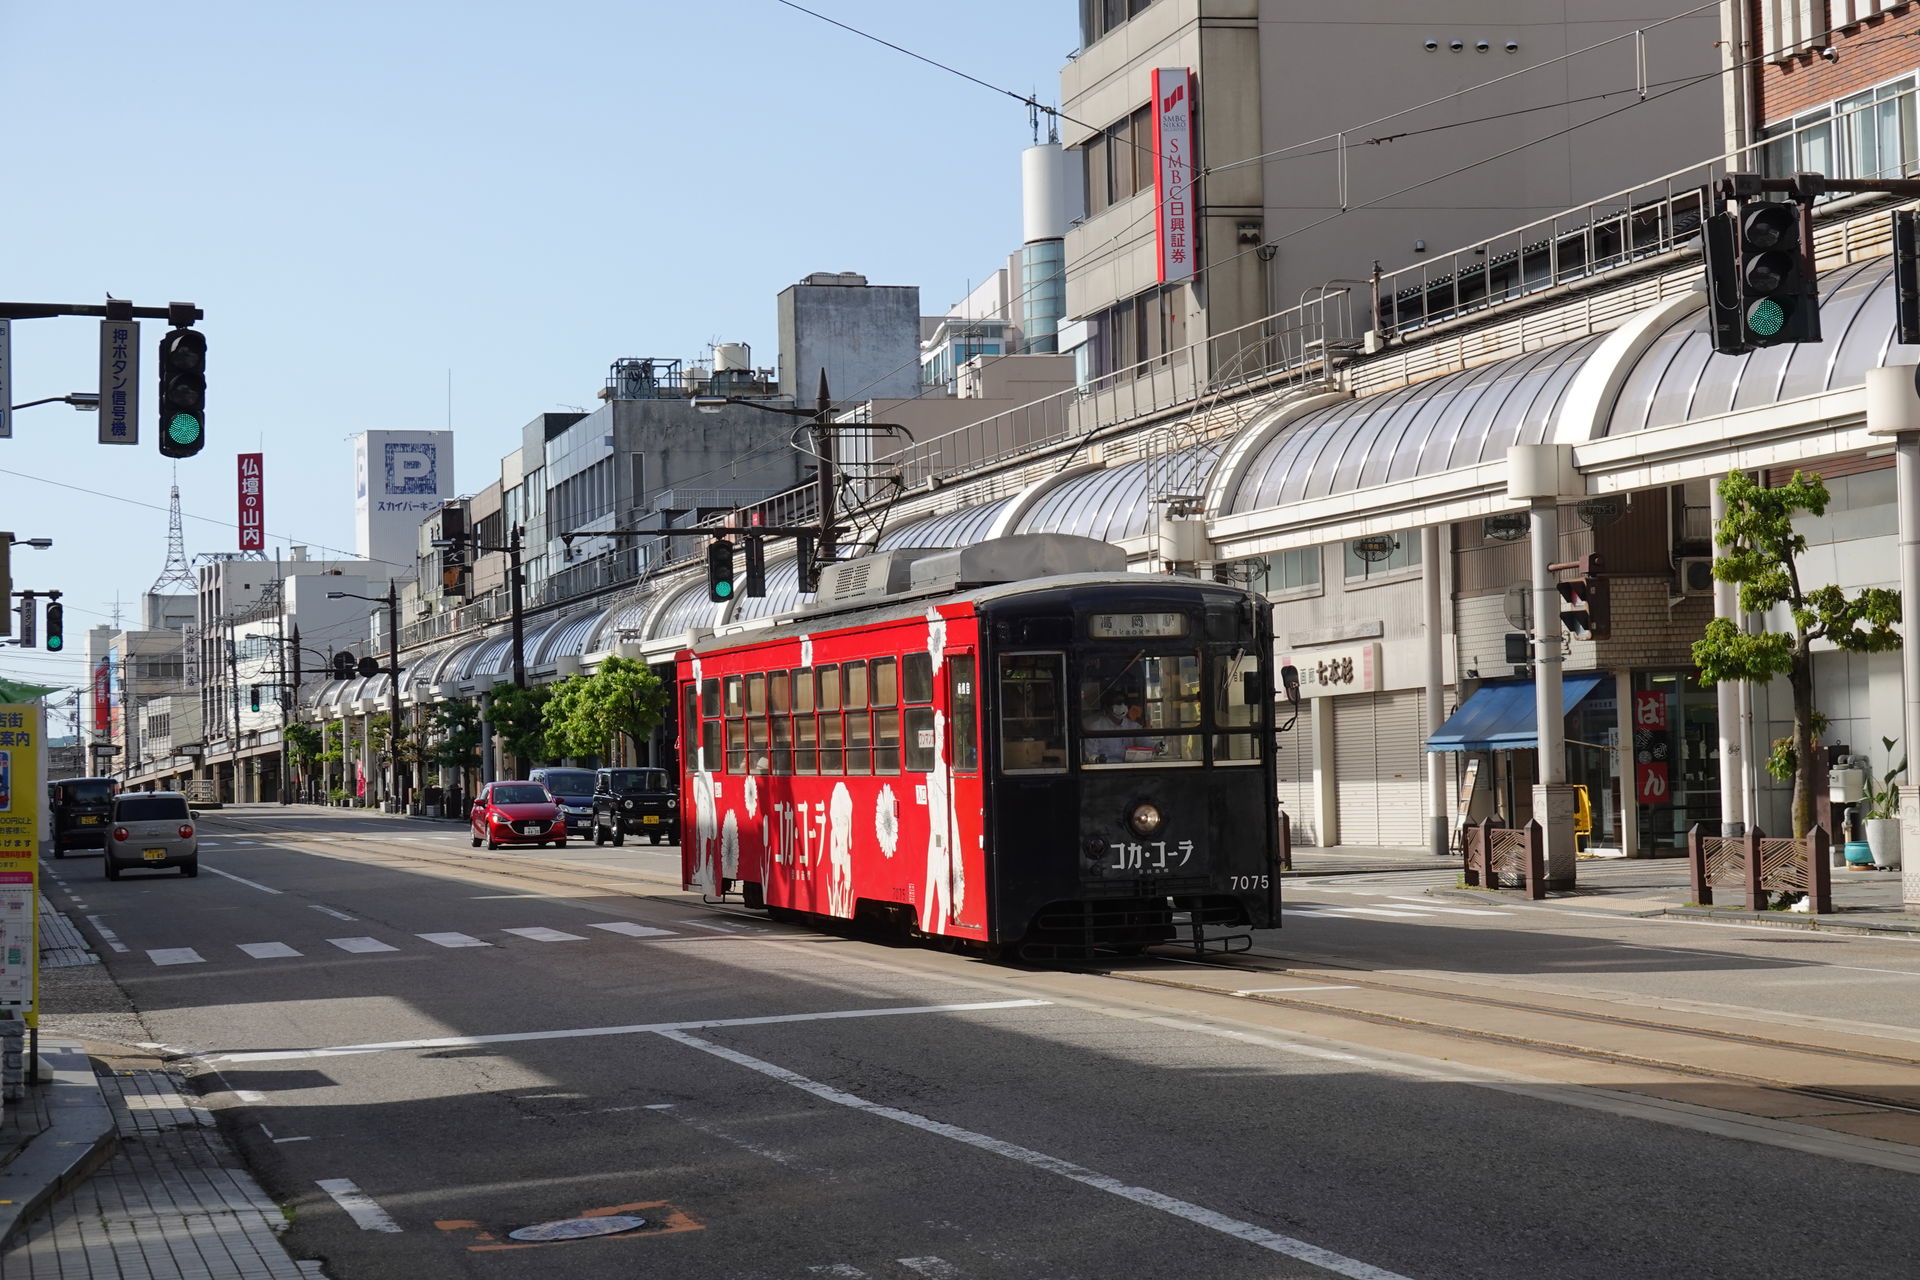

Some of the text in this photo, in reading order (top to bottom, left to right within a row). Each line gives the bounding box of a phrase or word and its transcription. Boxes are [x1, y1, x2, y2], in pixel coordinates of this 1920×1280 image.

[1163, 115, 1186, 123] SMBC
[1168, 138, 1186, 264] SMBC日興証券
[111, 329, 128, 437] 押ボタン信号機
[242, 458, 260, 546] 仏壇の山内
[1316, 657, 1354, 687] 七本杉
[774, 800, 827, 868] コカ・コーラ
[1110, 839, 1194, 870] コカ・コーラ
[1230, 874, 1269, 891] 7075
